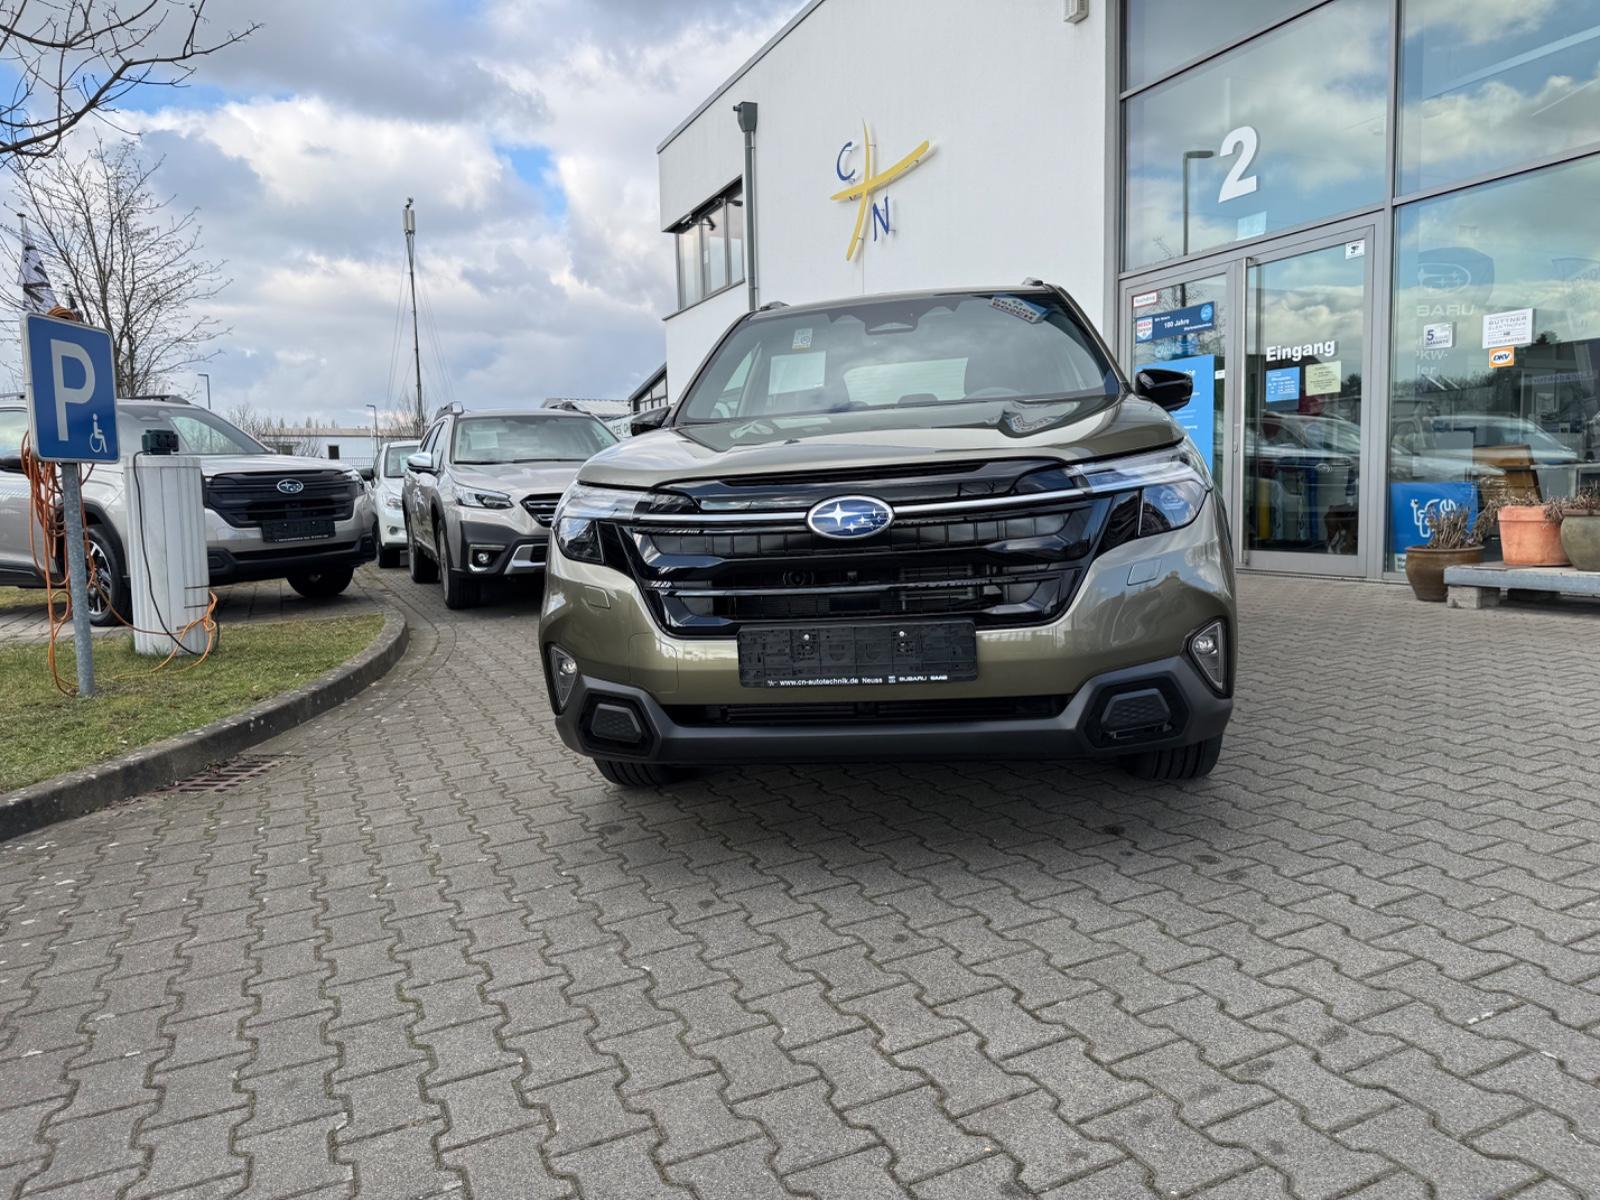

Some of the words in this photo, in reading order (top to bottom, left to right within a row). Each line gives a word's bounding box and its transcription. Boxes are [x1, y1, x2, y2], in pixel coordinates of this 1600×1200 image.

[836, 141, 855, 181] C
[1219, 125, 1258, 203] 2
[872, 196, 890, 242] N
[1174, 319, 1190, 327] Jahre
[1426, 329, 1435, 341] 5
[1266, 340, 1335, 362] Eingang
[1493, 352, 1510, 362] DKV
[50, 339, 96, 442] P
[779, 677, 859, 687] www.cn-autotechnik.de
